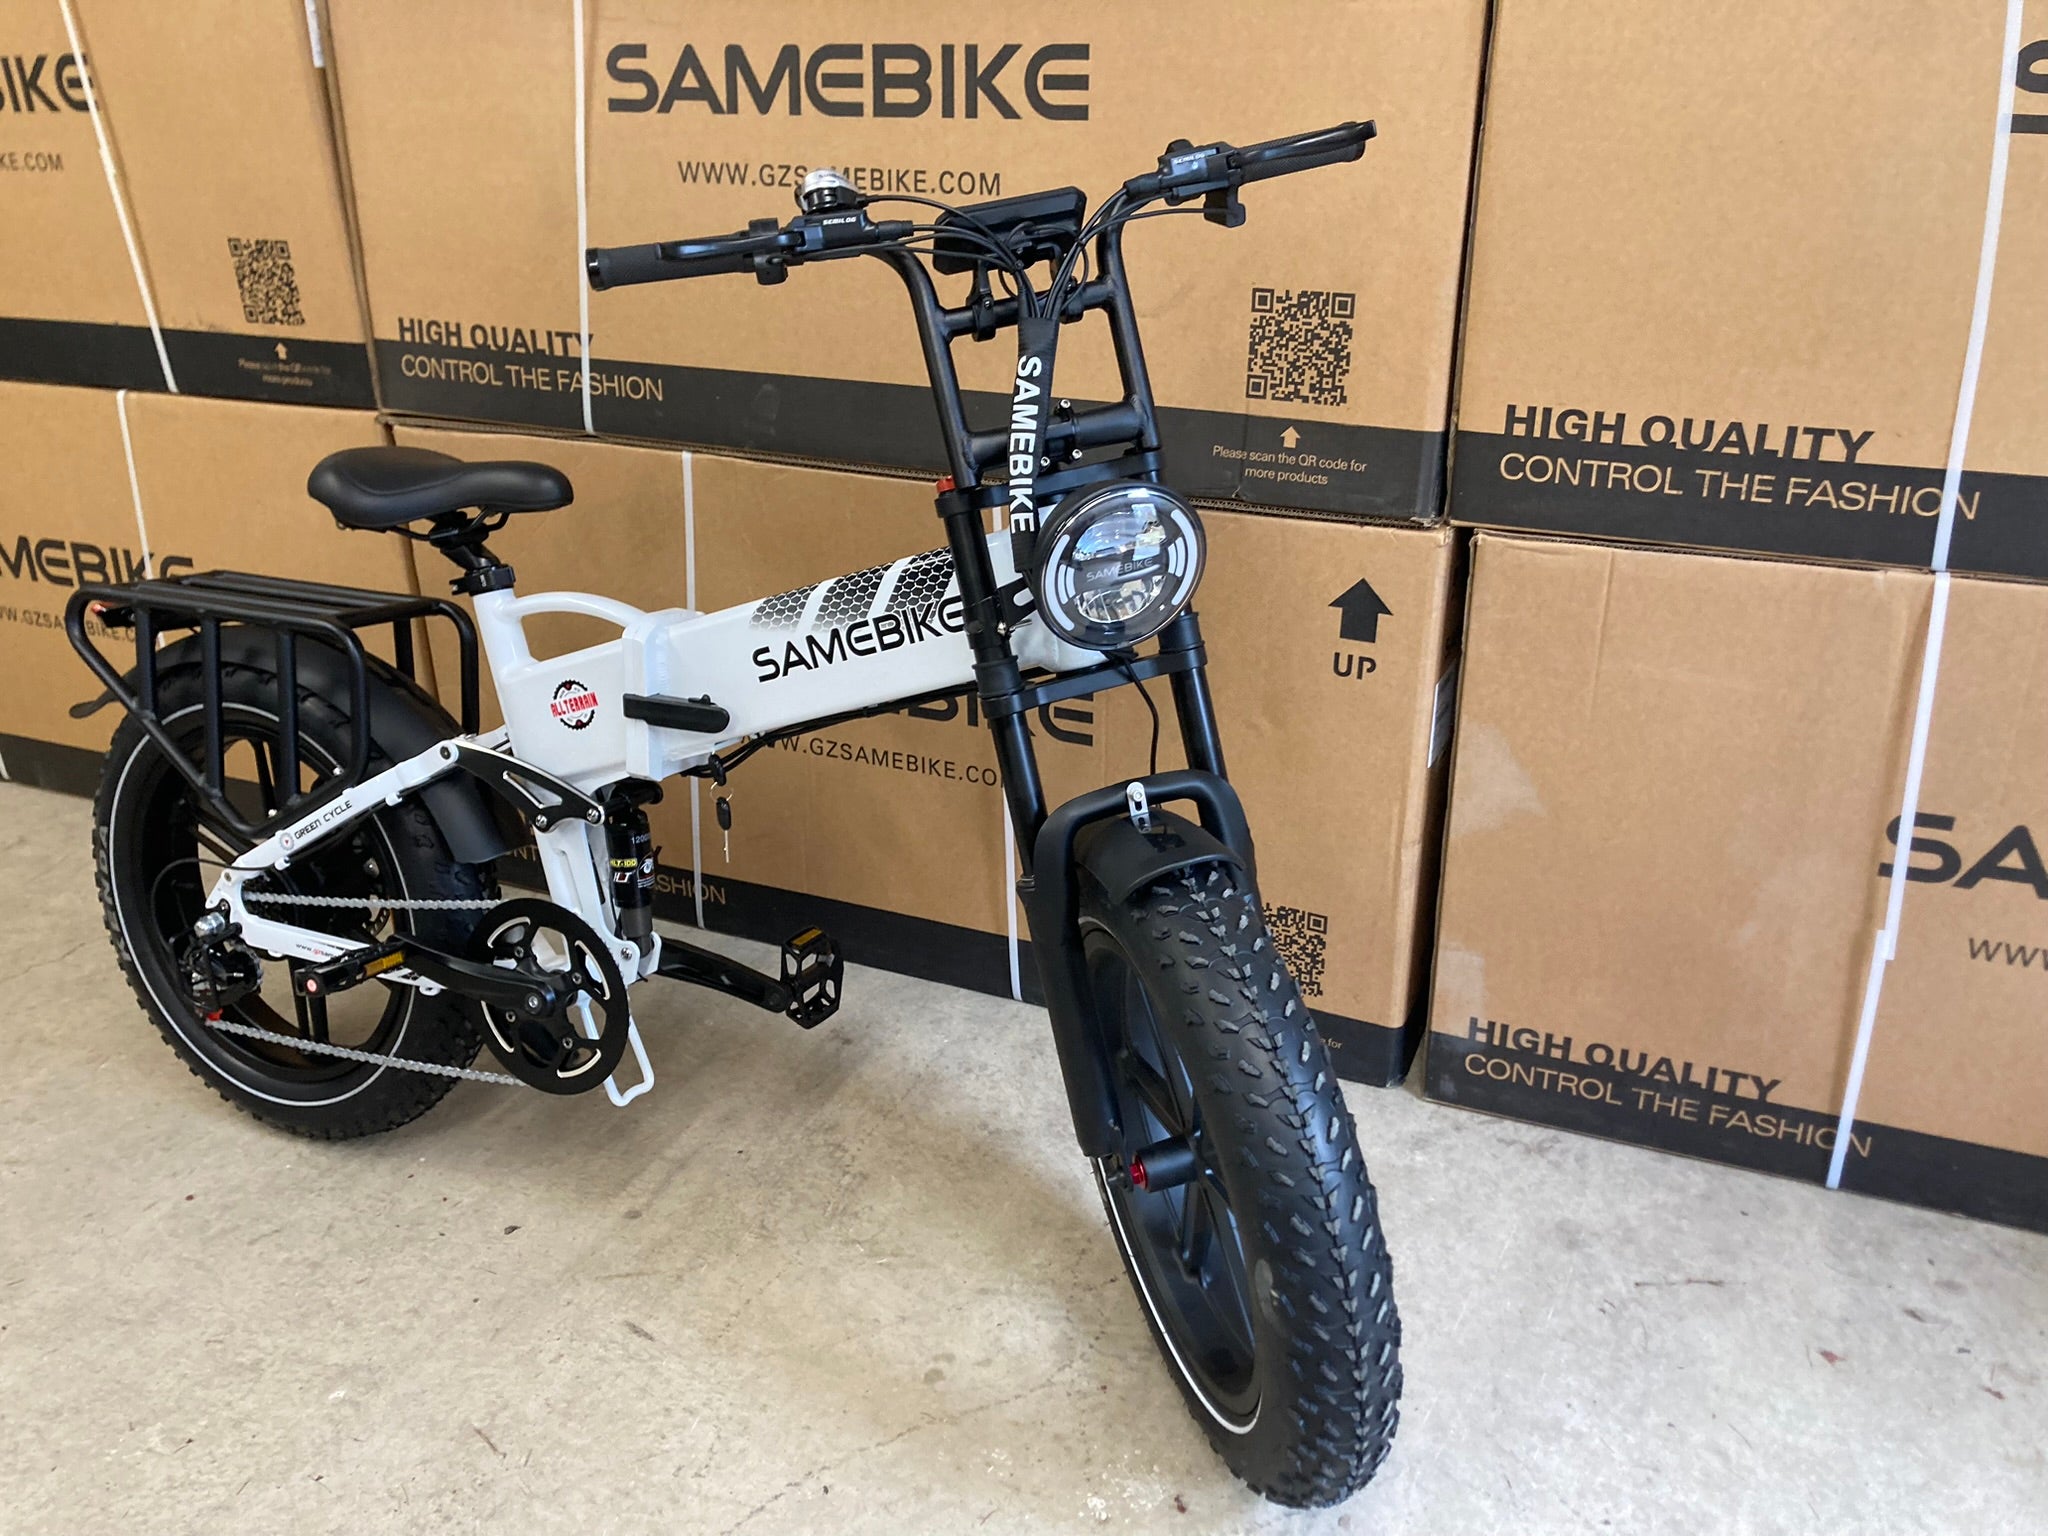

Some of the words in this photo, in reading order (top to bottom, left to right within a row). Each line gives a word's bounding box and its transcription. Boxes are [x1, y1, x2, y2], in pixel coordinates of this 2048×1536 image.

[0, 53, 98, 112] IKE
[606, 43, 1090, 121] SAMEBIKE
[678, 160, 1001, 196] WWW.GZSEBIKE.COM
[398, 317, 463, 348] HIGH
[401, 354, 503, 386] CONTROL
[505, 365, 552, 391] THE
[556, 370, 664, 401] FASHION
[1009, 355, 1042, 534] SAMEBIKE
[1503, 404, 1627, 446] HIGH
[1641, 415, 1876, 464] QUALITY
[1213, 445, 1247, 460] Please
[1249, 450, 1276, 463] scan
[1278, 453, 1297, 465] the
[1298, 454, 1317, 467] QR
[1319, 458, 1348, 471] code
[1350, 460, 1368, 472] for
[1244, 468, 1275, 479] more
[1277, 470, 1329, 485] products
[1500, 452, 1683, 495] CONTROL
[1695, 469, 1775, 503] THE
[1785, 478, 1980, 520] FASHION
[1086, 558, 1154, 582] SAMEBIKE
[752, 594, 965, 683] SAMEBIKE
[1333, 652, 1377, 680] UP
[294, 818, 322, 839] GREEN
[323, 800, 352, 822] CYCLE
[1328, 1038, 1343, 1048] for
[1467, 1016, 1573, 1060] HIGH
[1585, 1043, 1782, 1102] QUALITY
[1464, 1053, 1622, 1106] CONTROL
[1632, 1087, 1698, 1122] THE
[1708, 1104, 1872, 1159] FASHION
